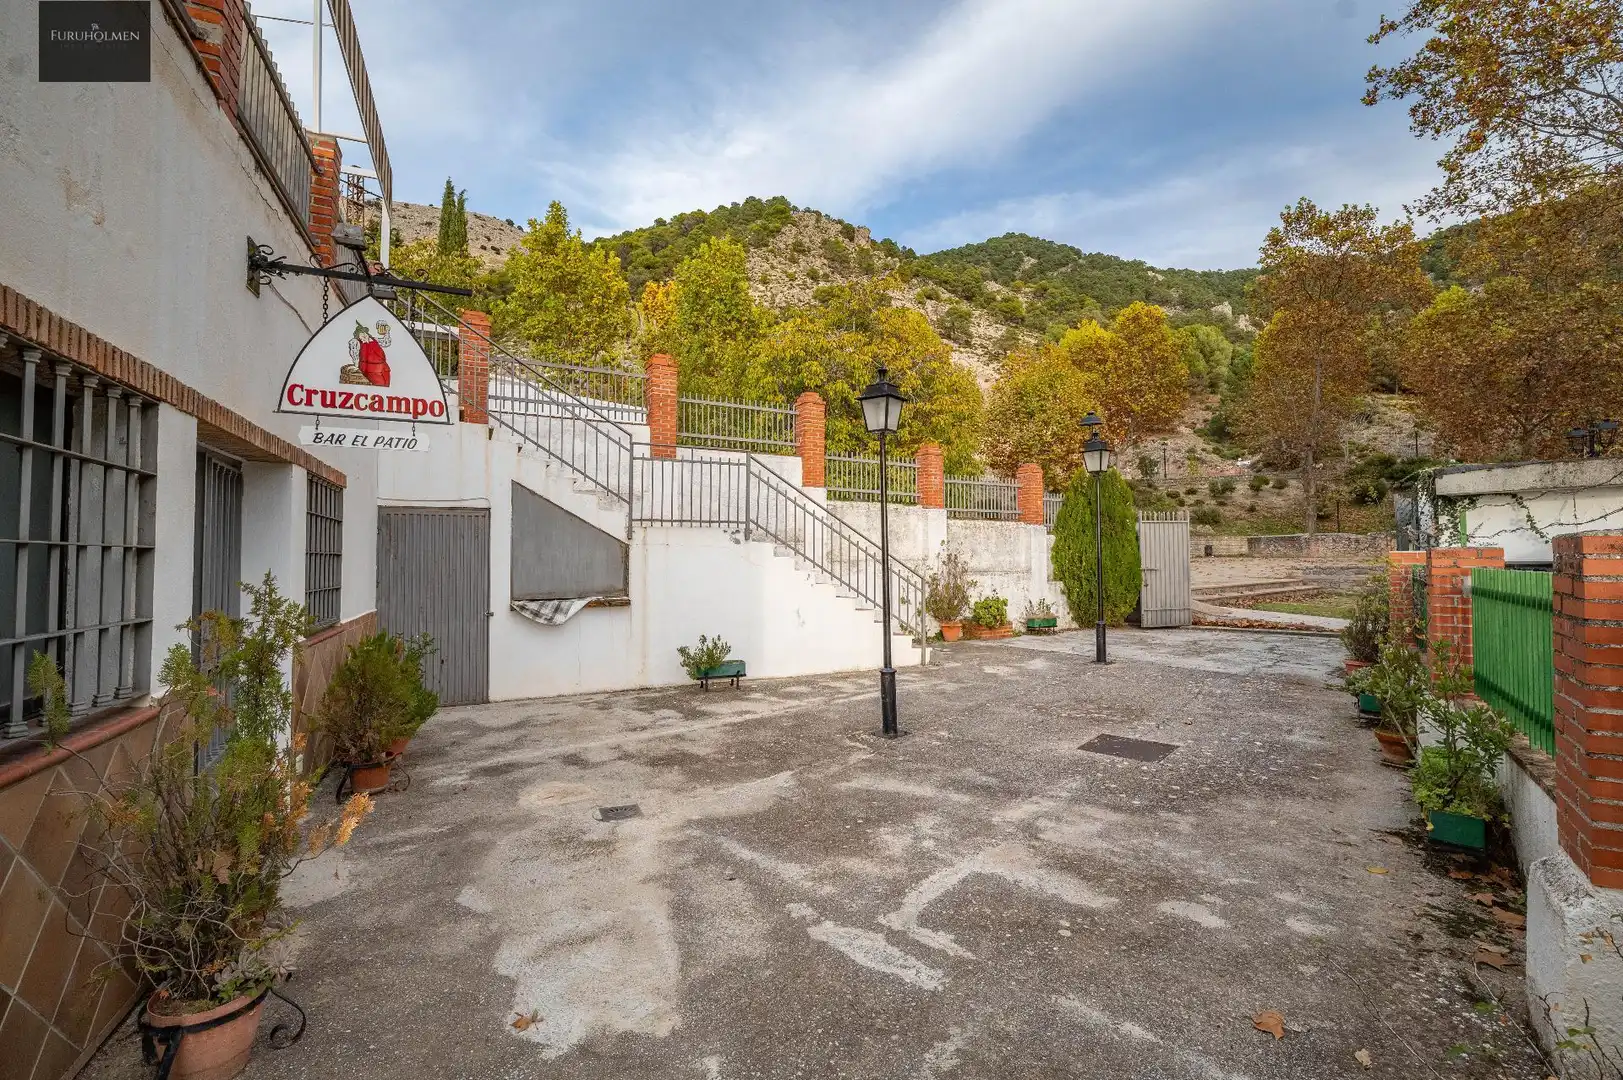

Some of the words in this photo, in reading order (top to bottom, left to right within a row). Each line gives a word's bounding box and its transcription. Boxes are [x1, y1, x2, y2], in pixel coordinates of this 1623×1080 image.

[287, 384, 444, 419] Cruzcampo
[313, 432, 346, 446] BAR
[351, 435, 367, 446] EL
[374, 436, 417, 450] PATIO
